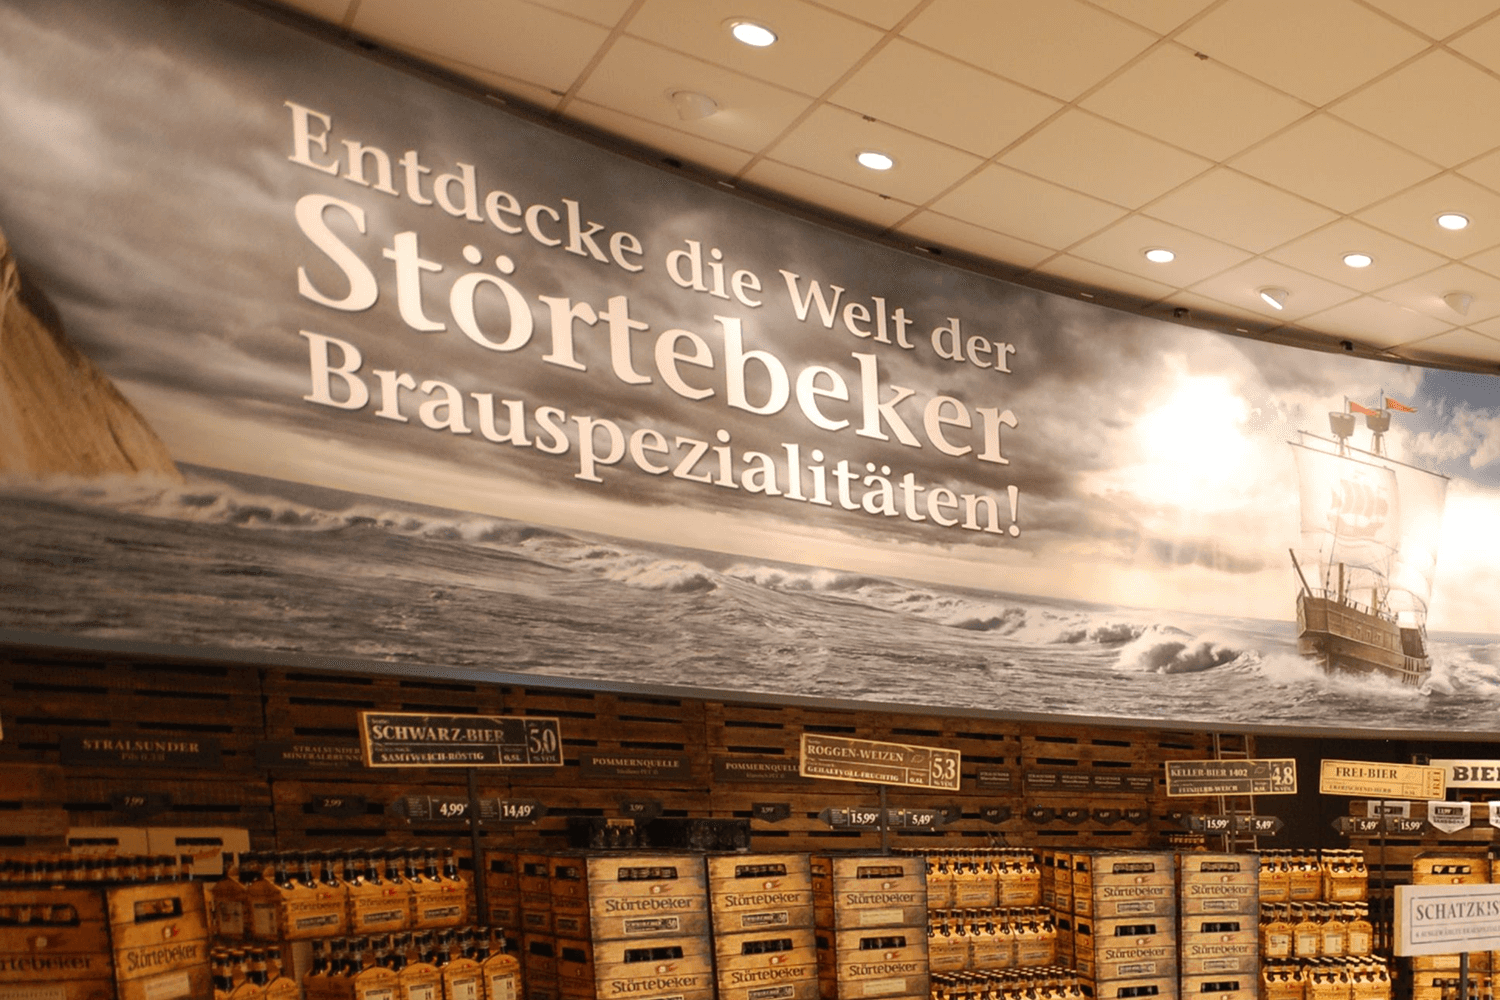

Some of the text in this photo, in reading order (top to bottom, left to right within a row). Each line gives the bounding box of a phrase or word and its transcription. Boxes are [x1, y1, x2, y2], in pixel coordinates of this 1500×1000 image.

[283, 101, 1016, 374] Entdecke die Welt der
[296, 193, 1018, 466] Störtebeker
[300, 330, 1021, 539] Brauspezialitäten!
[372, 725, 505, 742] SCHWARZ-BIER
[530, 729, 557, 753] 5,0
[82, 738, 199, 753] STRALSUNDER
[807, 745, 904, 762] ROGGEN-WEIZEN
[381, 751, 484, 762] SAMTWEICH-RÖSTIG
[591, 757, 680, 769] POMMERNQUELLE
[725, 762, 799, 772] POMMERNQUELL
[807, 765, 899, 782] GEHALTVOLL-FRUCHTIG
[932, 757, 956, 780] 5,3
[1170, 769, 1248, 777] KELLER-BIER 1402
[1336, 766, 1398, 780] FREI-BIER
[1272, 766, 1294, 785] 4,8
[1103, 885, 1166, 898] Störtebeker
[1191, 884, 1252, 897] Störtebeker
[605, 898, 692, 912] Störtebeker
[724, 892, 801, 908] Störtebeker
[846, 892, 916, 906] Störtebeker
[127, 942, 198, 973] Störtebeker
[1105, 946, 1166, 961] Störtebeker
[1191, 943, 1251, 956] Störtebeker
[731, 965, 806, 984] Störtebeker
[849, 961, 918, 977] Störtebeker
[611, 975, 699, 994] Störtebeker
